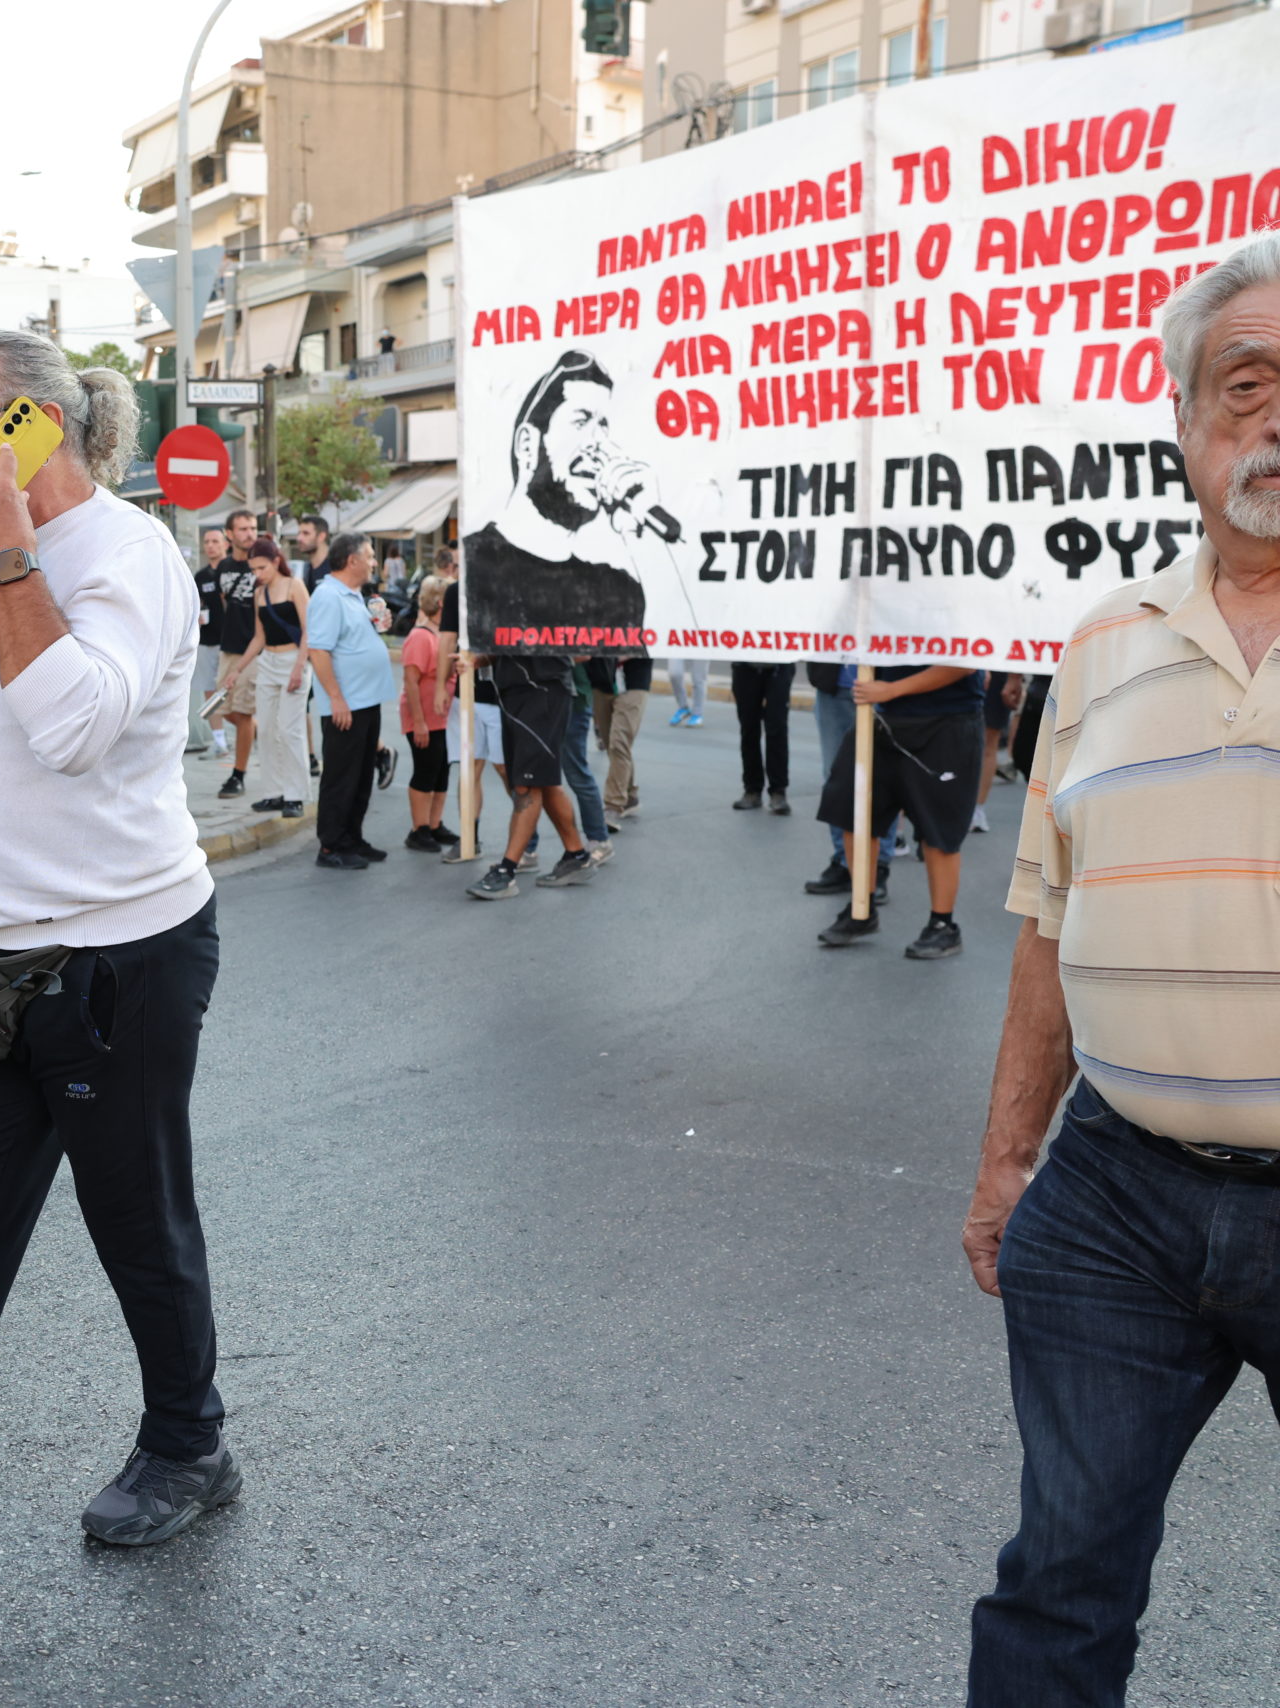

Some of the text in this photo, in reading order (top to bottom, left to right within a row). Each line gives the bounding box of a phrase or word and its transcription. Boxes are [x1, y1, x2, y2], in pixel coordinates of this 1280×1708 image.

[597, 103, 1176, 278] ΠΑΝΤΑ ΝΙΚΑΕΙ ΤΟ ΔΙΚΙΟ!
[471, 304, 542, 347] ΜΙΑ
[554, 287, 641, 338] ΜΕΡΑ
[656, 272, 707, 326] ΘΑ
[719, 230, 901, 311] ΝΙΚΗΣΕΙ
[915, 222, 952, 281] Ο
[652, 333, 733, 379] ΜΙΑ
[750, 308, 873, 367] ΜΕΡΑ
[895, 297, 927, 350] Η
[192, 385, 255, 399] ΣΑΛΑΜΙΝΟΣ
[655, 337, 1178, 441] ΘΑ ΝΙΚΗΣΕΙ ΤΟΝ ΠΟ
[739, 440, 1197, 519] ΤΙΜΗ ΓΙΑ ΠΑΝΤΑ
[699, 517, 1206, 584] ΣΤΟΝ ΠΑΥΛΟ ΦΥΣ
[494, 626, 658, 647] ΠΡΟΛΕΤΑΡΙΑΚΟ
[668, 629, 857, 652] ΑΝΤΙΦΑΣΙΣΤΙΚΟ
[868, 635, 994, 657] ΜΕΤΩΠΟ
